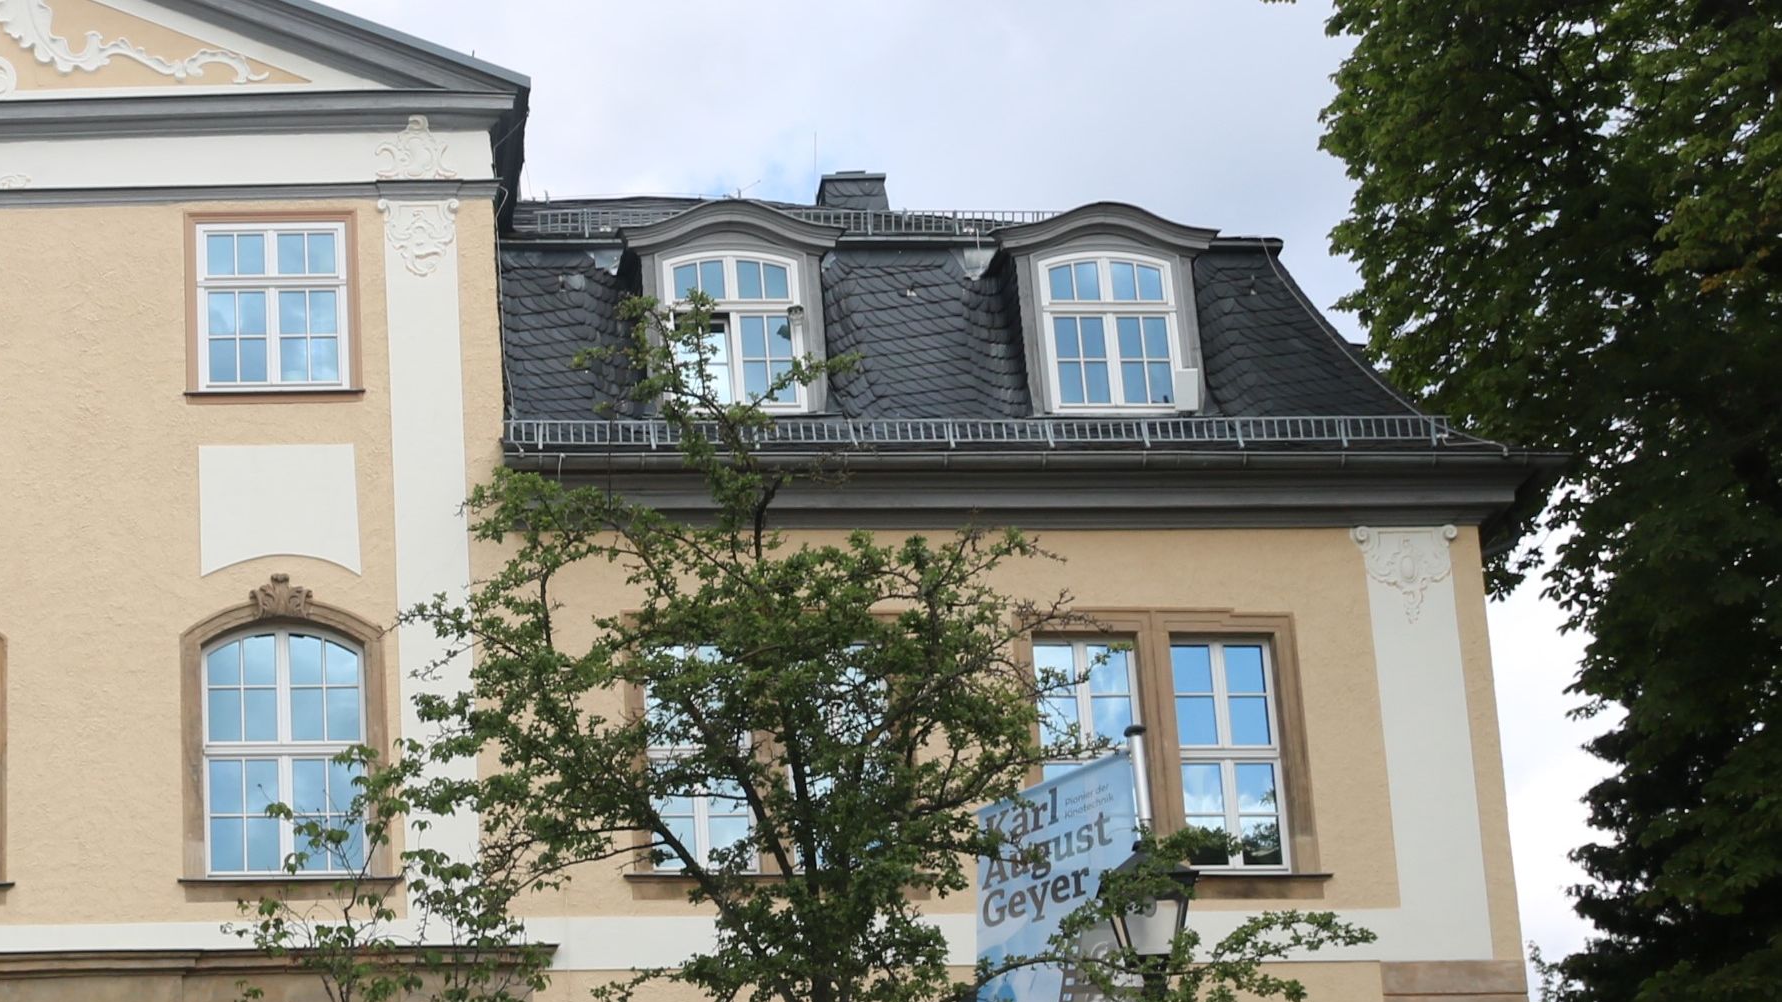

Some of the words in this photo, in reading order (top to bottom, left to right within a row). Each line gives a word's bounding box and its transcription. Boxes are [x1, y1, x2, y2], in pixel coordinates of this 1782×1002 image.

[984, 787, 1059, 841] Karl
[982, 812, 1113, 891] August
[982, 865, 1090, 928] Geyer
